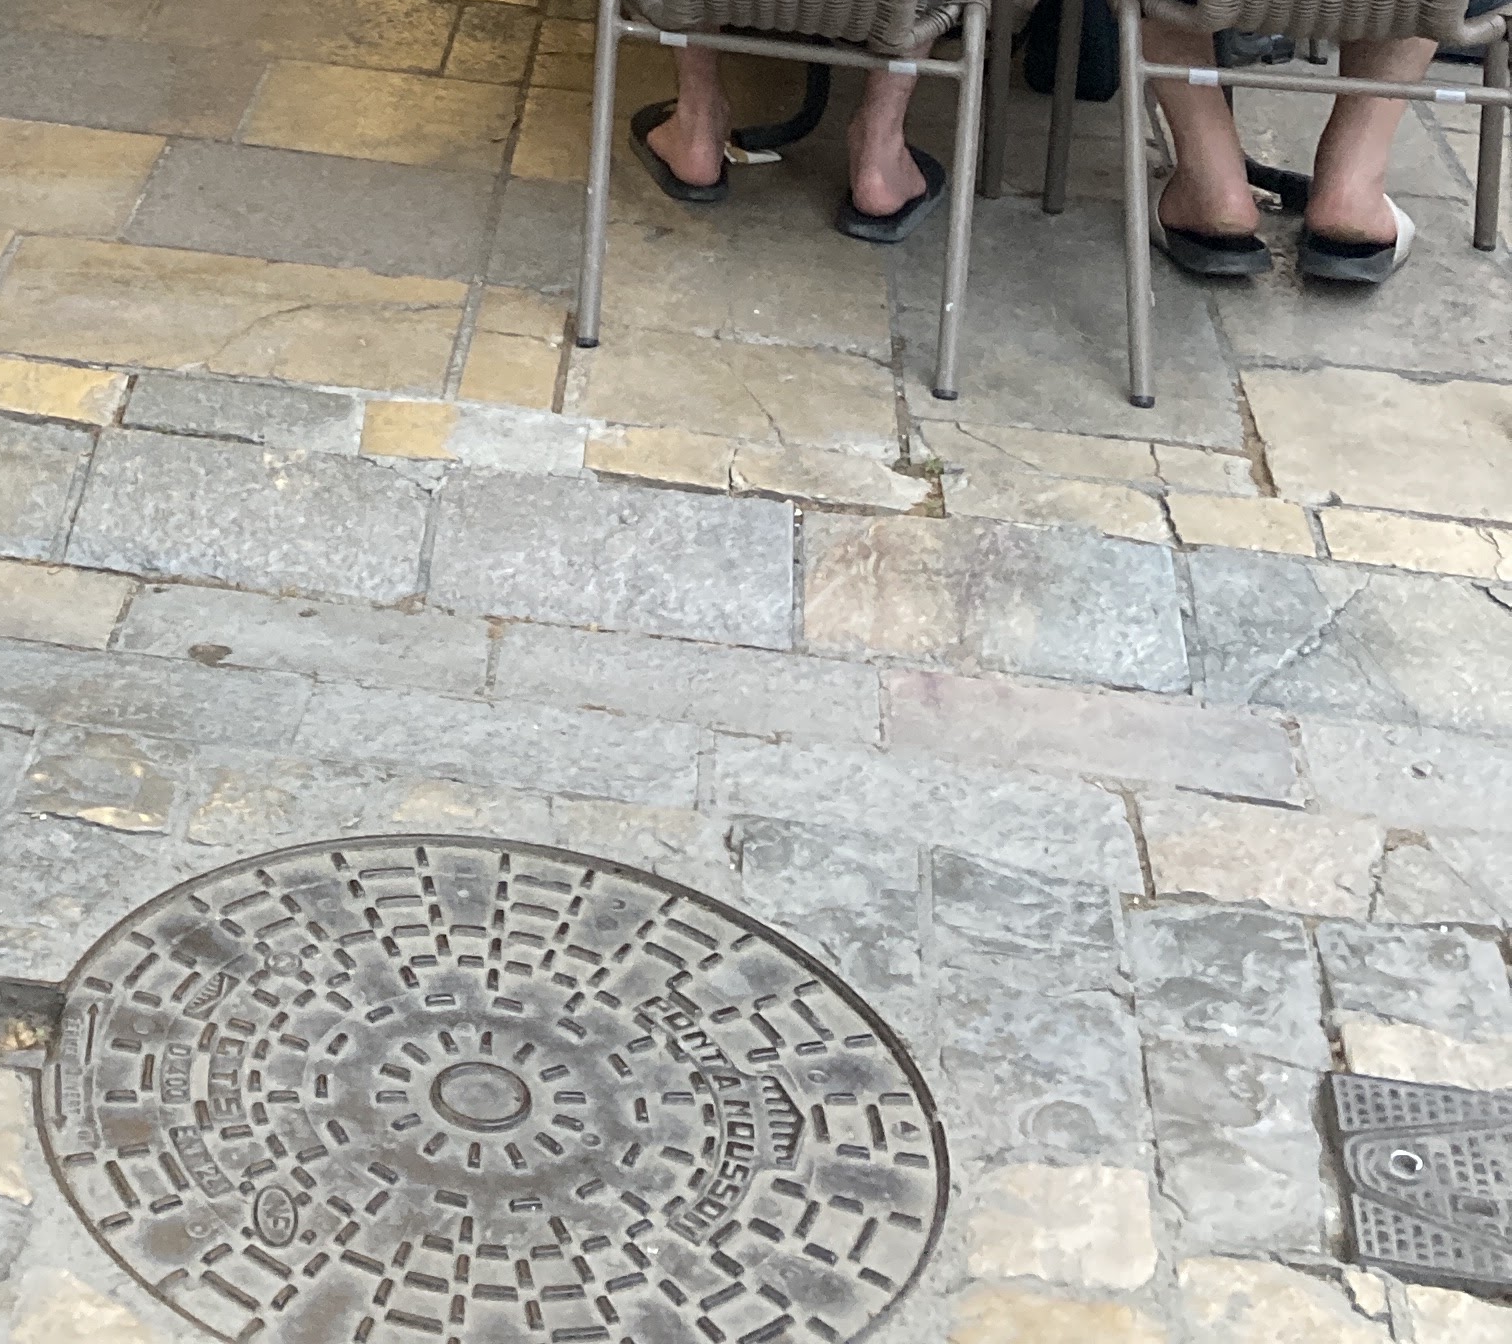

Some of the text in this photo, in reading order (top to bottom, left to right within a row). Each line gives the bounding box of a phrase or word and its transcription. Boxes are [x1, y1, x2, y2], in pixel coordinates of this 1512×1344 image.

[642, 996, 757, 1247] PONT A MOUSSON
